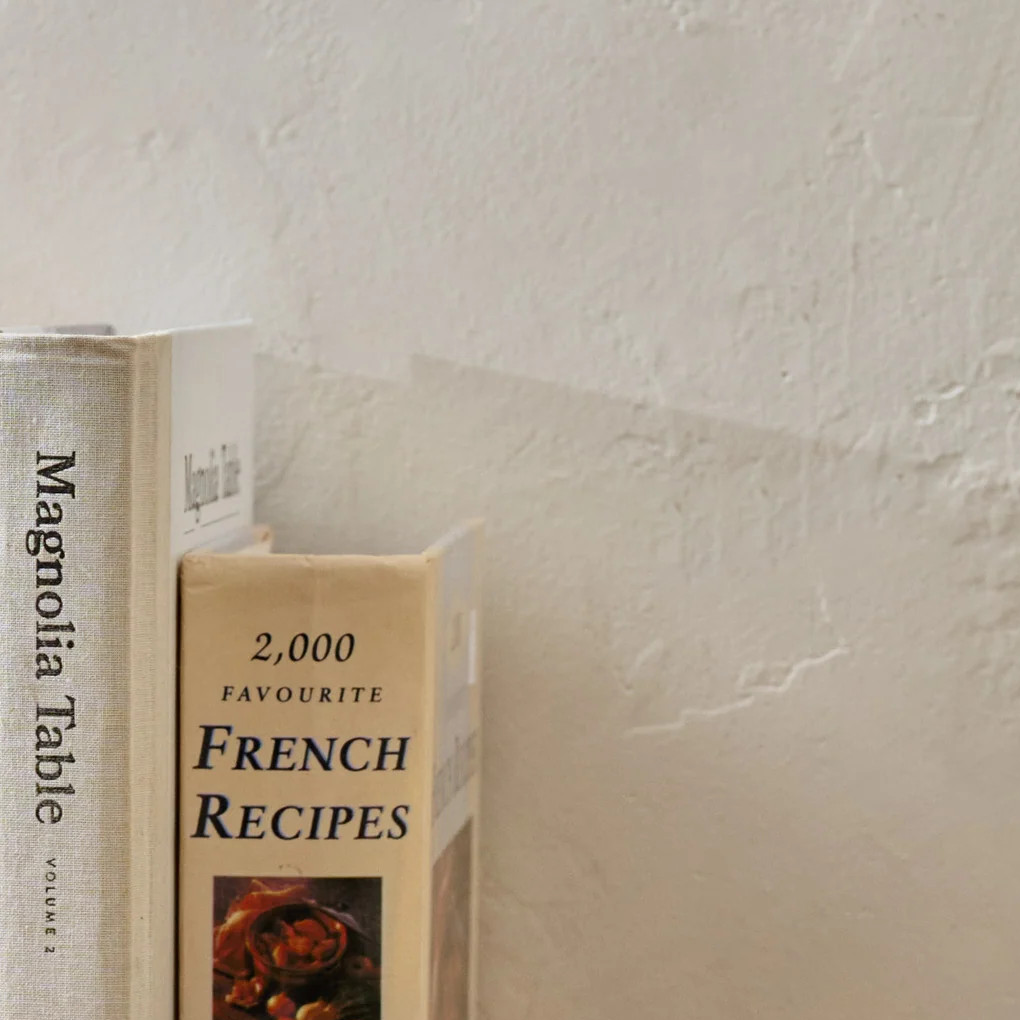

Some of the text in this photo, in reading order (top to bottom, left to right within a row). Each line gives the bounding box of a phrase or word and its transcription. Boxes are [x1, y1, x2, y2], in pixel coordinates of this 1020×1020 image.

[26, 451, 76, 824] Magnolia Table
[251, 632, 355, 666] 2,000
[221, 685, 383, 703] FAVOURITE
[192, 724, 411, 772] FRENCH
[190, 793, 410, 841] RECIPES
[44, 858, 56, 954] VOLUME 2
